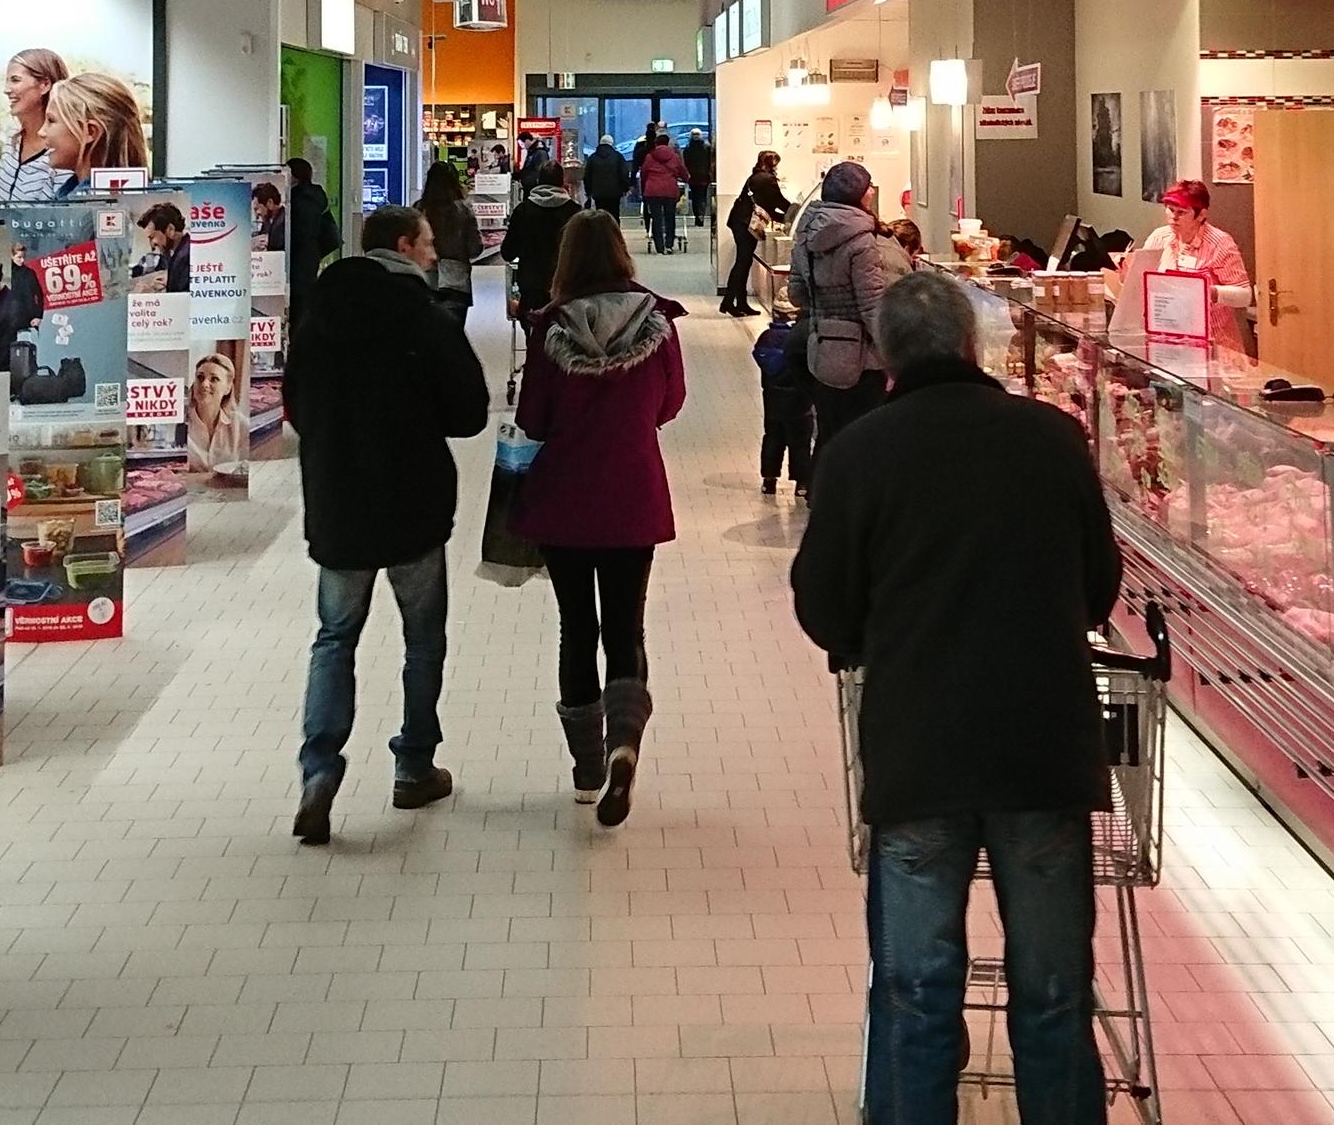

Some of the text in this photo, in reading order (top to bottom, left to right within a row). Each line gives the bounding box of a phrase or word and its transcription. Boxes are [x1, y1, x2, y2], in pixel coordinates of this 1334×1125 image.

[190, 201, 225, 220] aše
[11, 219, 83, 229] bugatti
[190, 221, 226, 229] avenka
[40, 253, 83, 269] UŠETŘÍTE
[196, 263, 224, 272] JEŠTĚ
[45, 264, 97, 294] 69%
[203, 275, 237, 284] PLATIT
[190, 289, 247, 298] RAVENKOU?
[132, 298, 161, 307] že má
[130, 309, 156, 317] valita
[131, 318, 173, 329] celý rok?
[251, 319, 276, 332] TVÝ
[251, 332, 276, 341] IKDY
[129, 381, 178, 400] STVÝ
[135, 399, 178, 411] NIKDY
